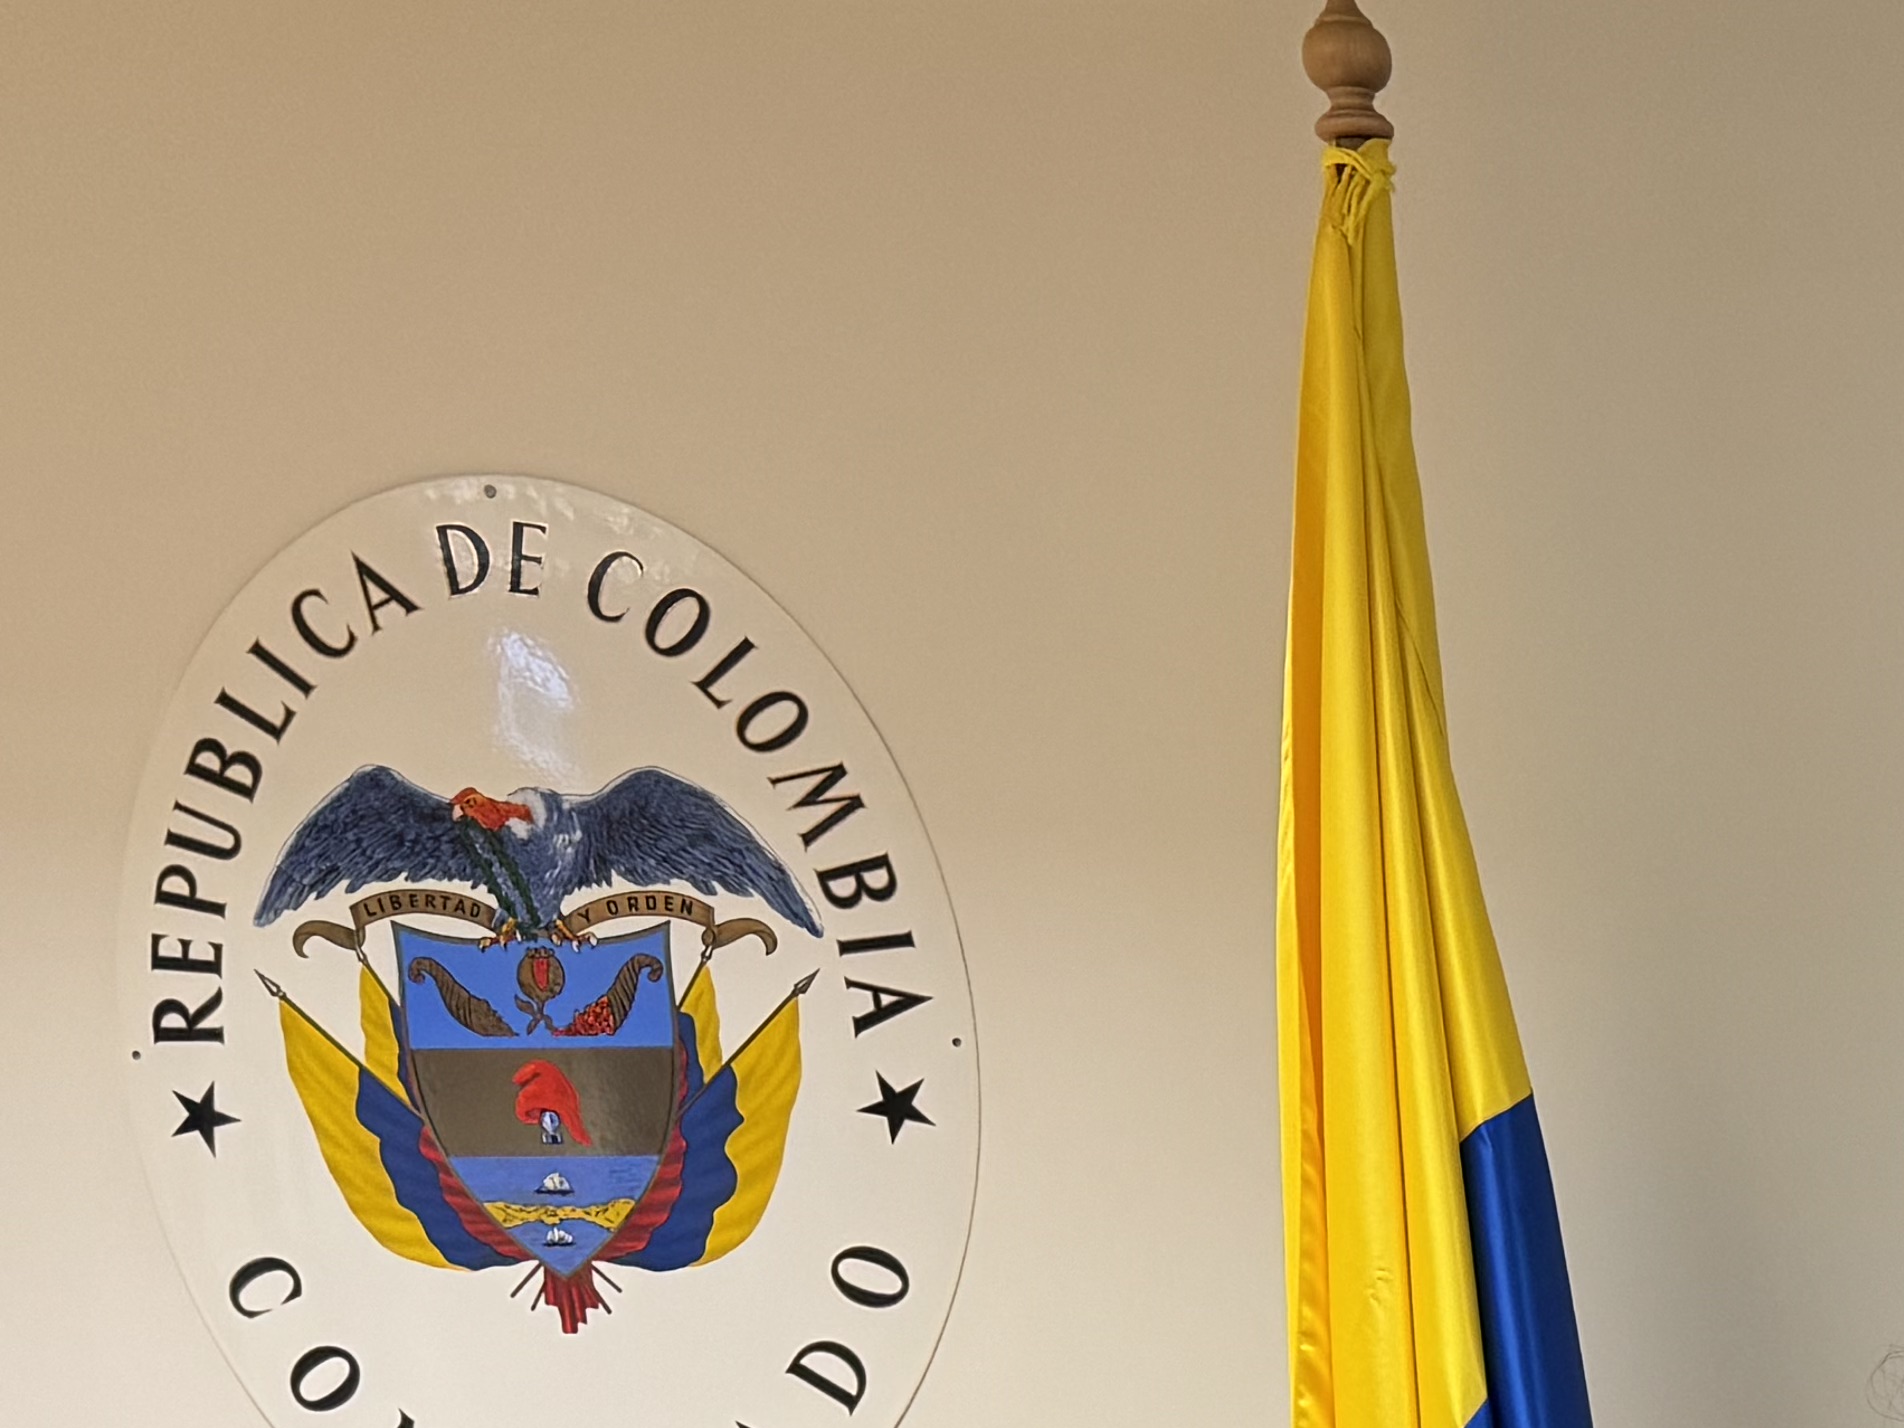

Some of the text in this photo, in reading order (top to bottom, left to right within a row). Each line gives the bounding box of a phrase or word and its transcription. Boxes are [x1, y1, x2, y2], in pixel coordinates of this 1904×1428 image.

[152, 520, 934, 1046] REPUBLICA DE COLOMBIA
[363, 894, 694, 925] LIBERTAD Y ORDEN
